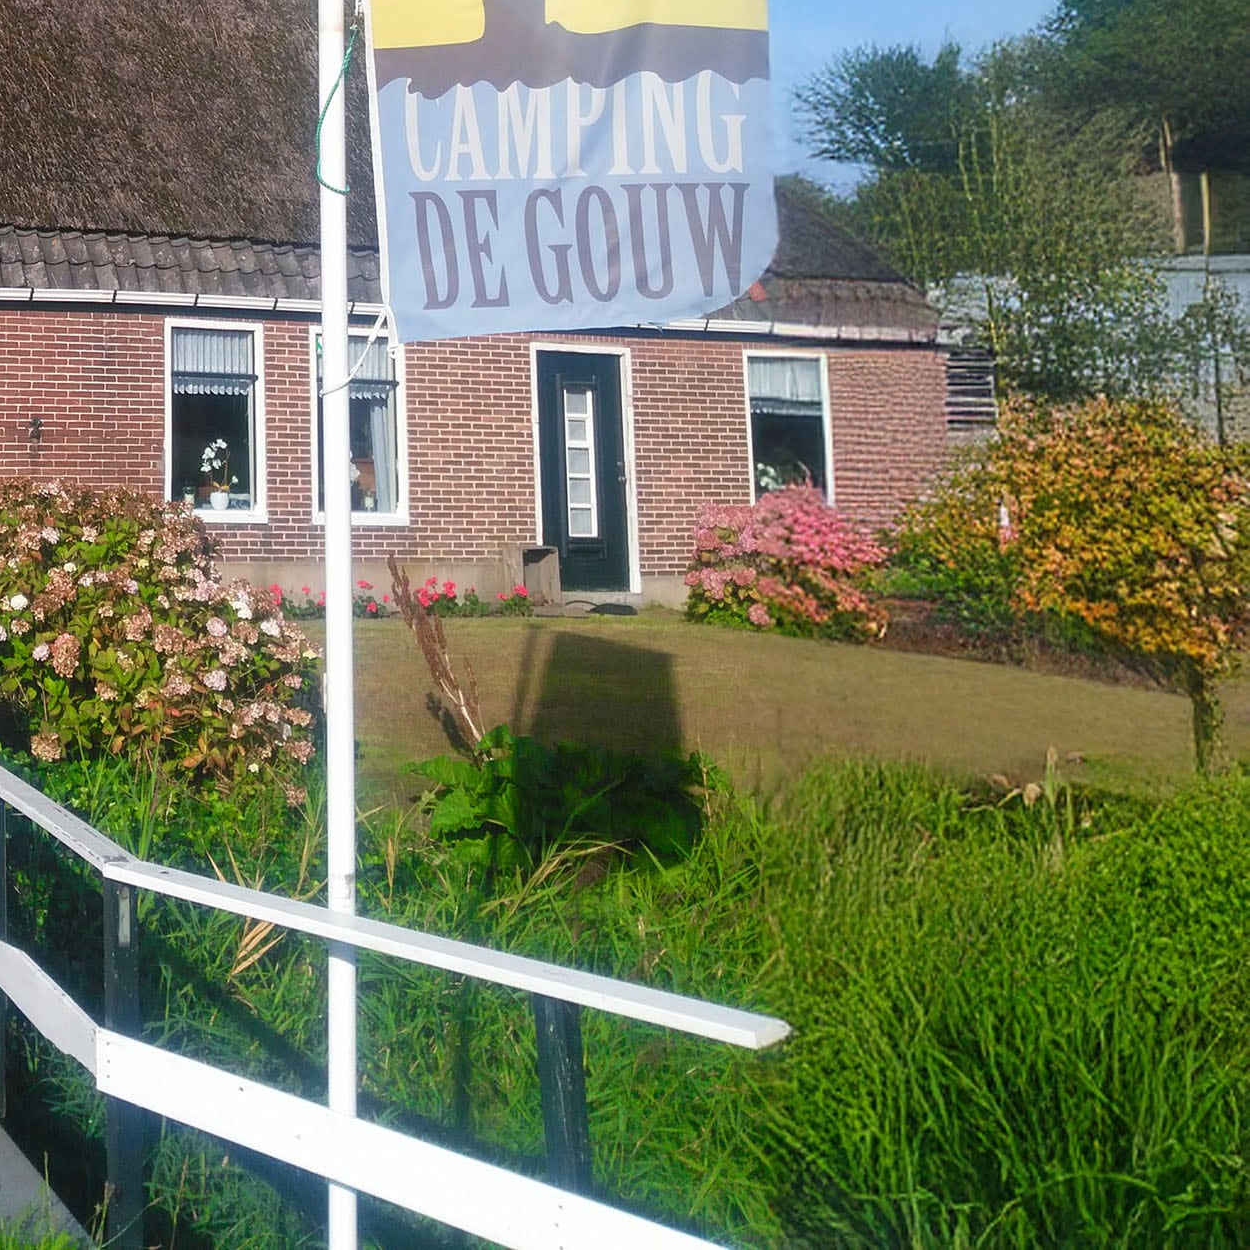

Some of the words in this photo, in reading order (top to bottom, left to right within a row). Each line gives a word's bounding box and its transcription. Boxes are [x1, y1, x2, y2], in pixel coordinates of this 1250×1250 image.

[405, 70, 747, 181] CAMPING
[409, 190, 510, 310] DE
[524, 183, 750, 305] GOUW
